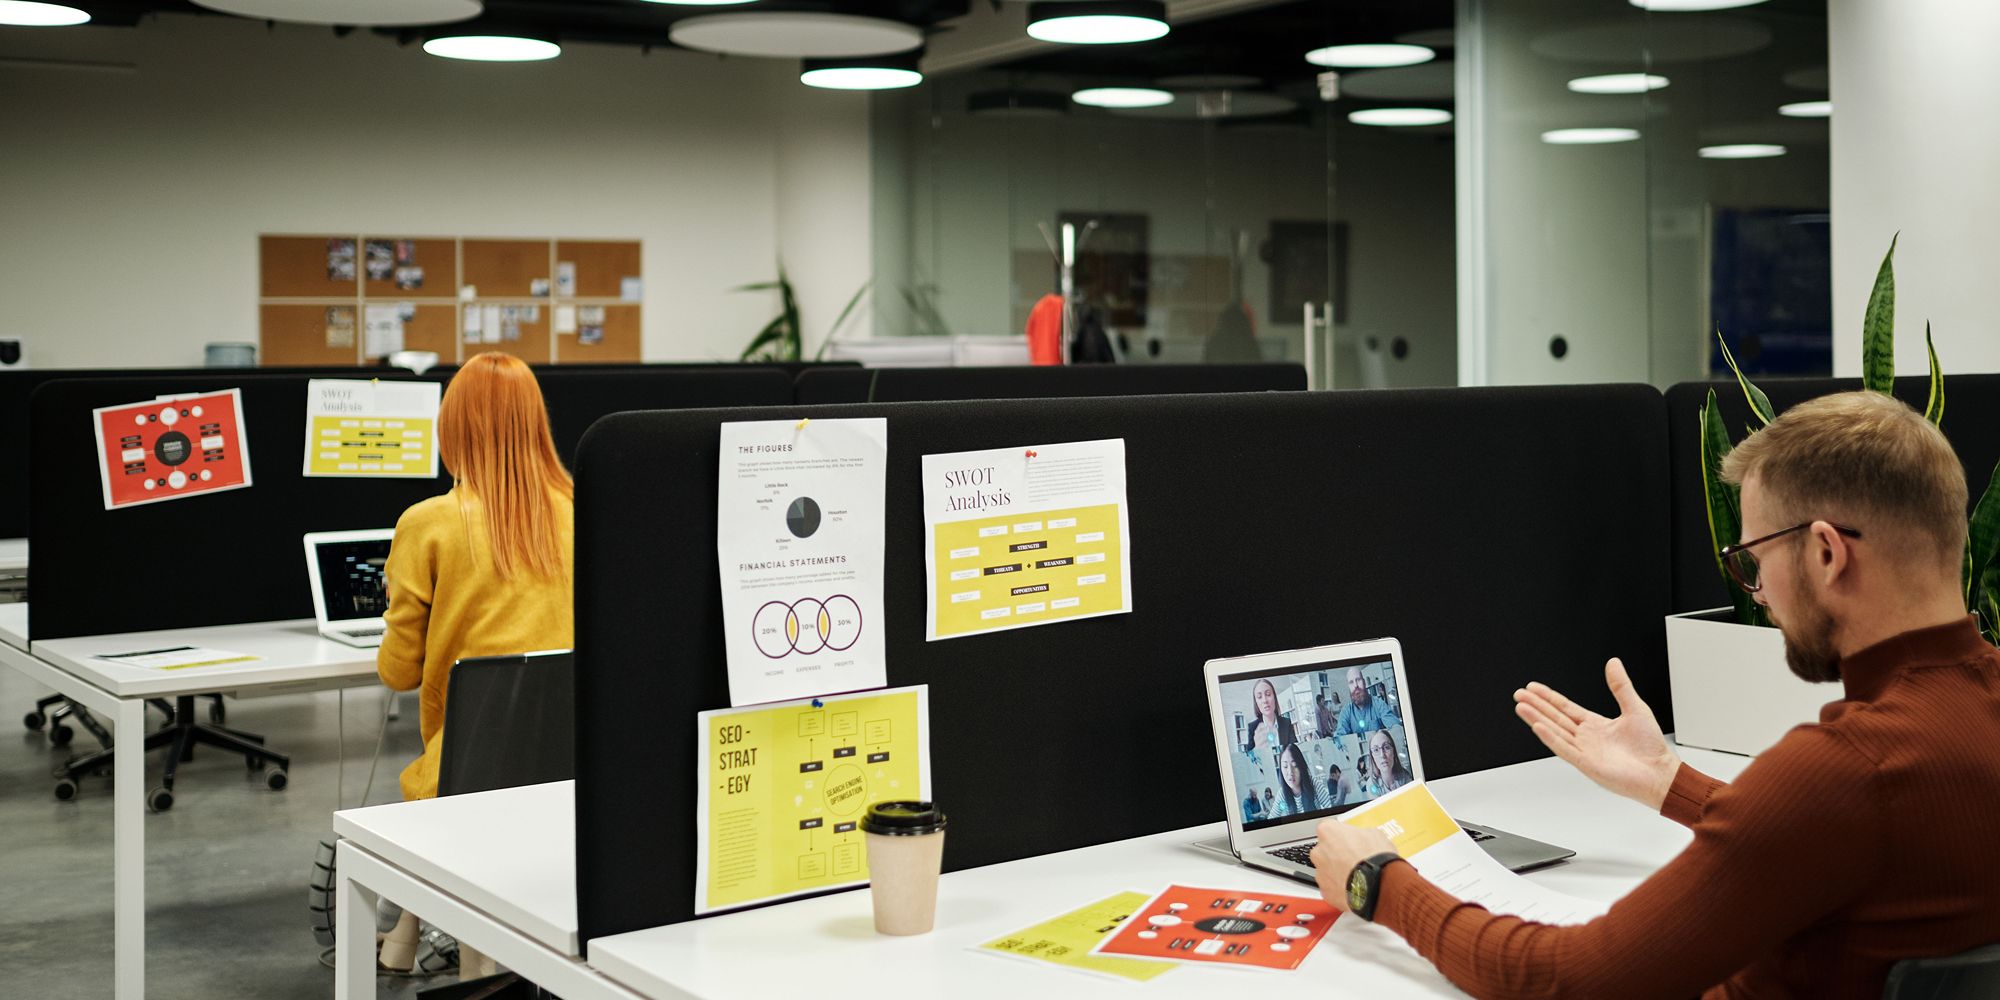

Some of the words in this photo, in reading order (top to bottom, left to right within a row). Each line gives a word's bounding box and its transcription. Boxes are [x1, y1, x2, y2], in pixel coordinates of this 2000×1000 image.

[321, 388, 352, 399] SWOT
[321, 402, 363, 412] Analysis
[757, 444, 793, 453] FIGURES
[945, 467, 995, 488] SWOT
[945, 488, 1011, 512] Analysis
[1017, 543, 1040, 551] STRENGTH
[739, 561, 787, 571] FINANCIAL
[790, 555, 847, 567] STATEMENTS
[762, 627, 776, 635] 20%
[719, 724, 743, 745] SEO
[719, 747, 758, 771] STRAT
[728, 774, 752, 795] EGY
[826, 784, 845, 798] SEARCH
[845, 775, 863, 791] ENGINE
[830, 785, 863, 806] OPTIMISATION
